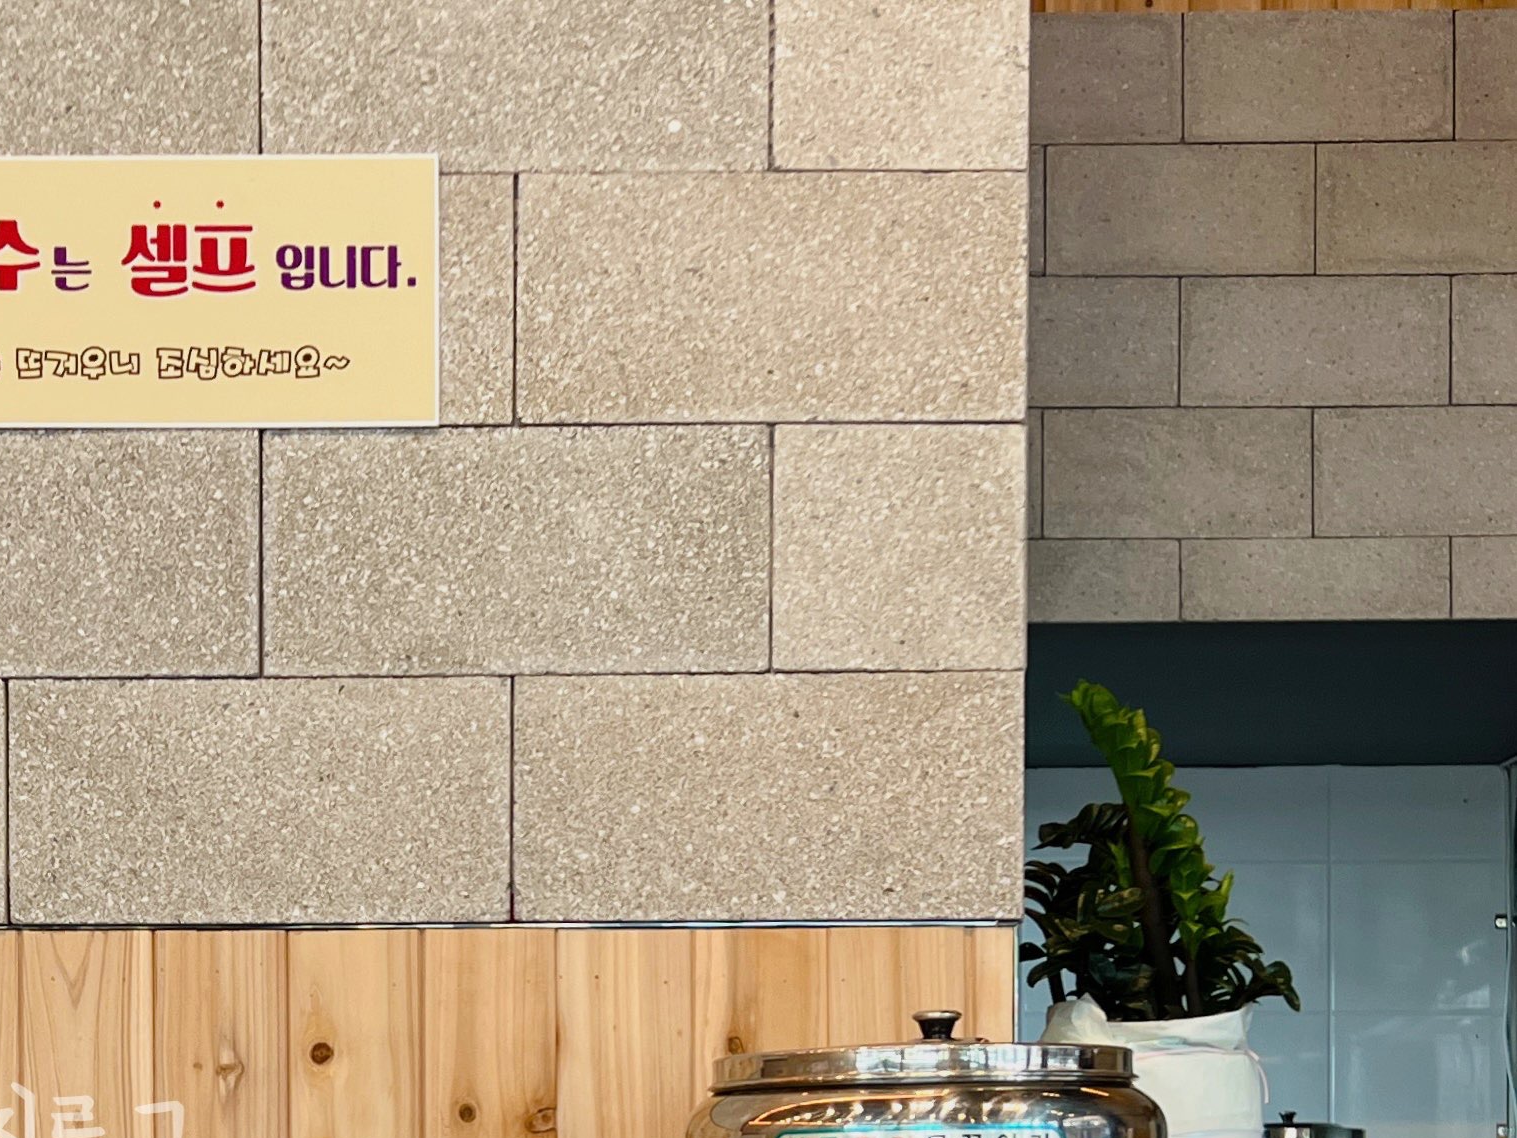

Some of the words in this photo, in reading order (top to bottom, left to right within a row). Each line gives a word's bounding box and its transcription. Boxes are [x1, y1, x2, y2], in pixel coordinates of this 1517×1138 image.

[120, 221, 257, 298] 셀프
[275, 243, 418, 290] 입니다.
[15, 346, 141, 381] 뜨거우니
